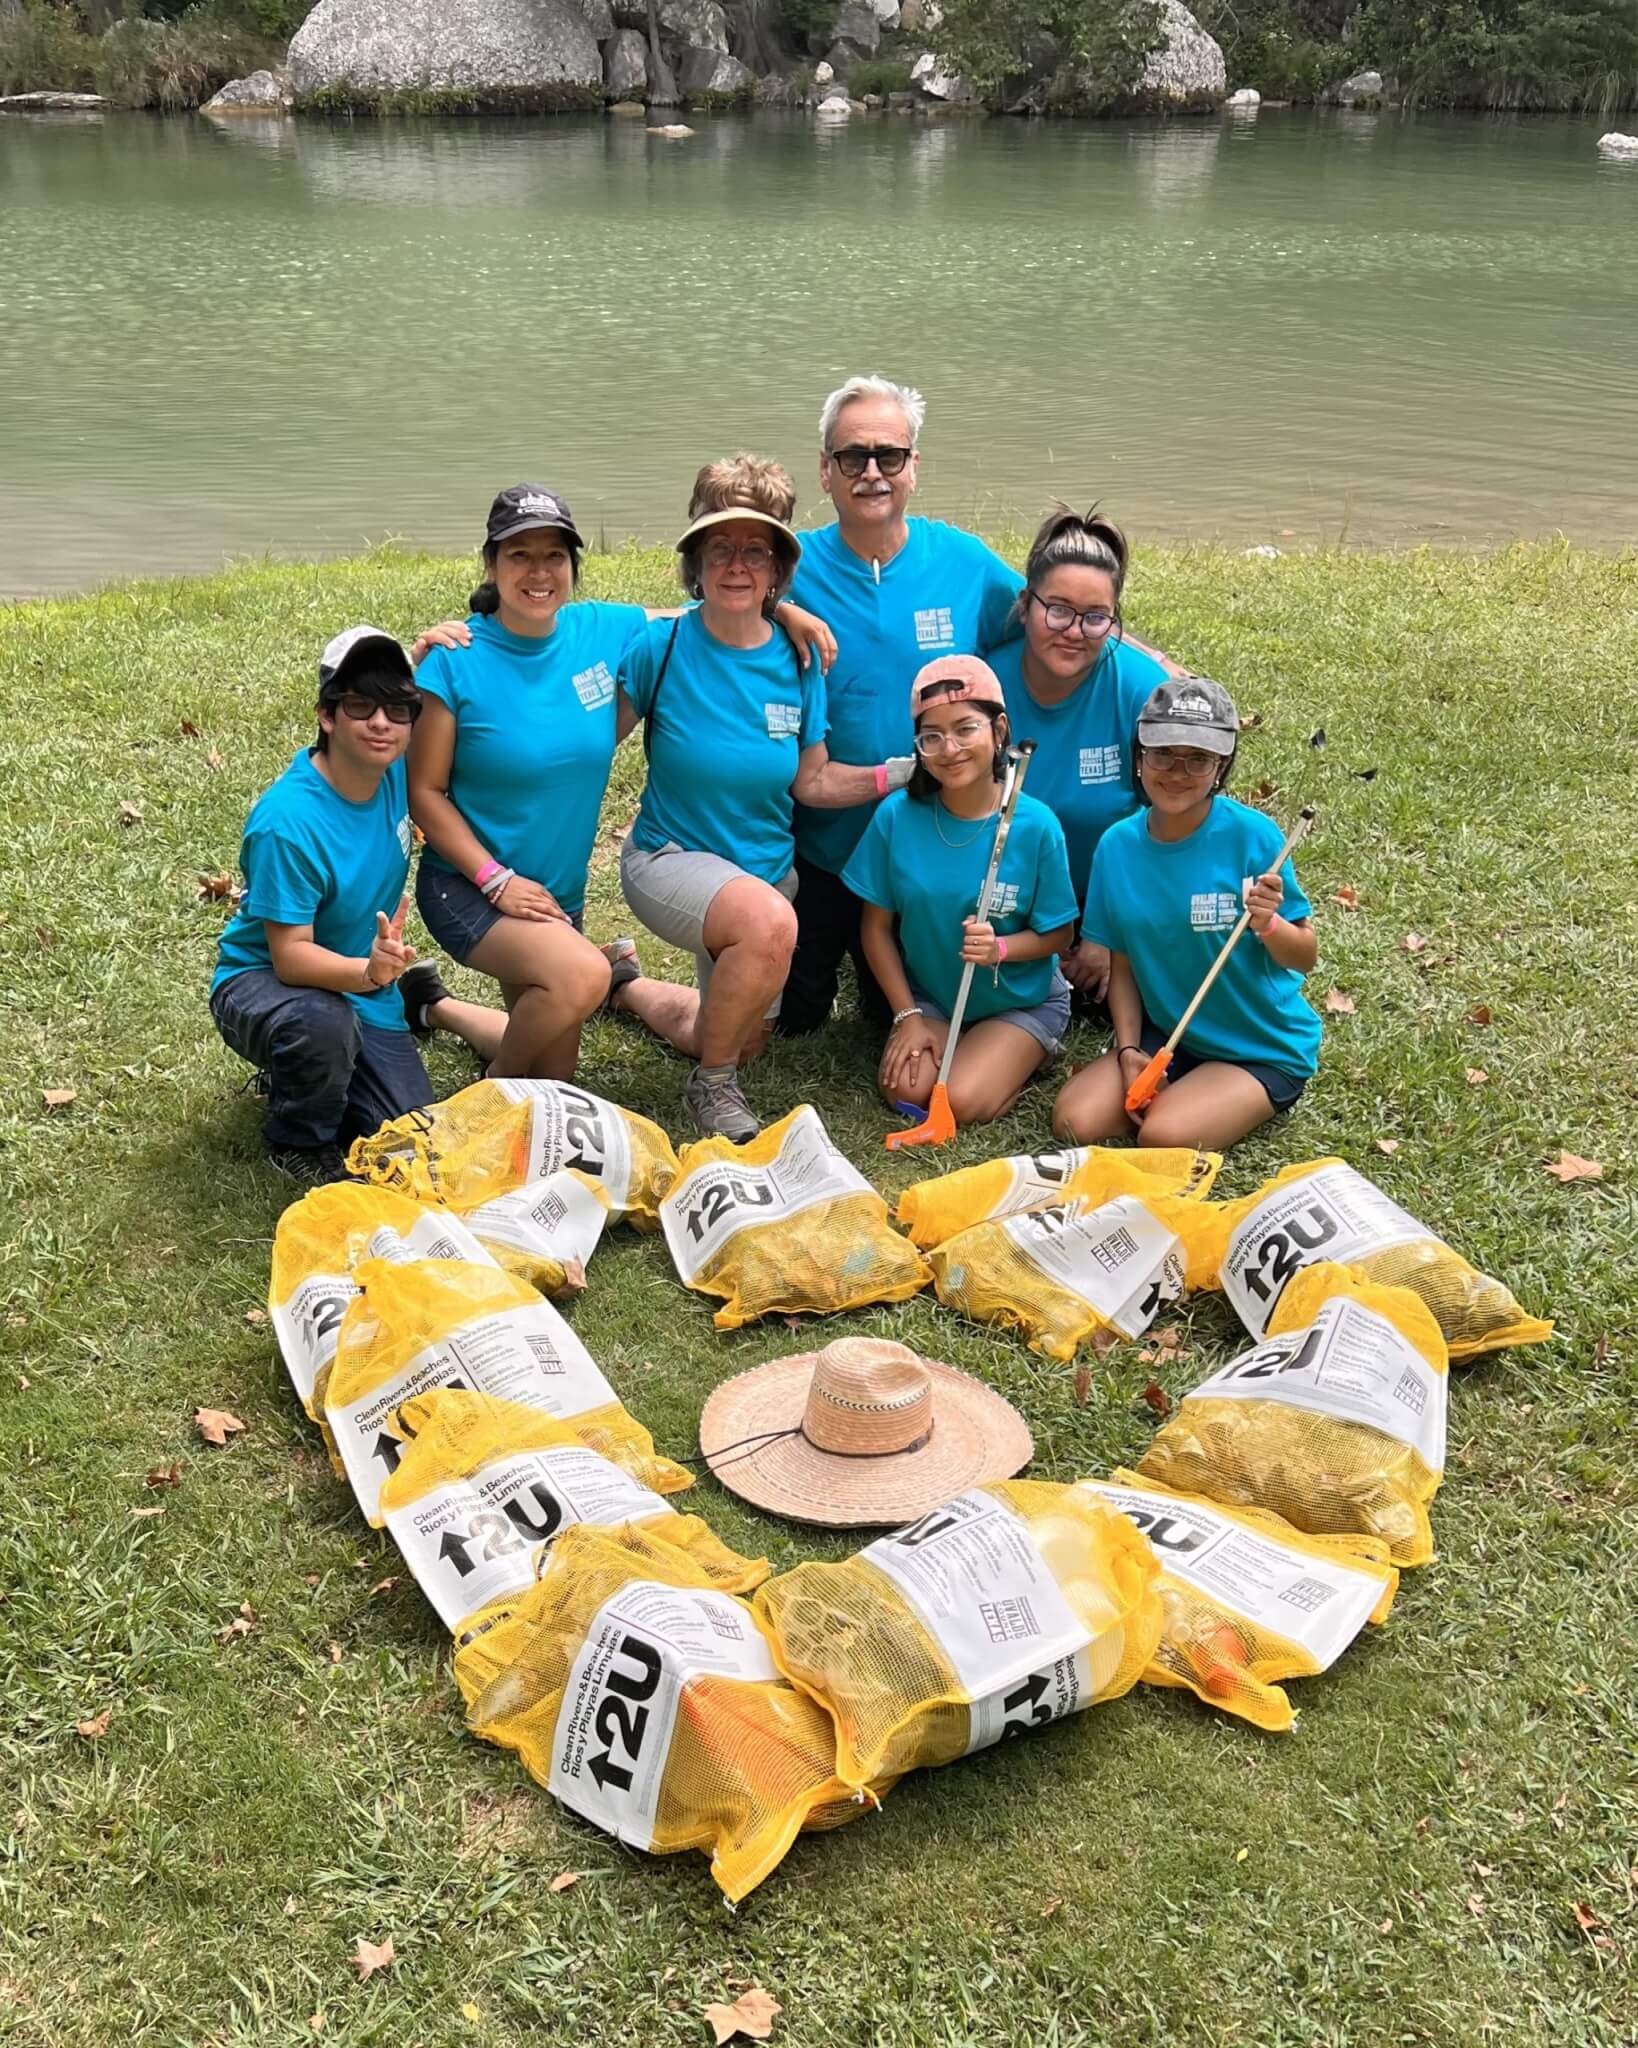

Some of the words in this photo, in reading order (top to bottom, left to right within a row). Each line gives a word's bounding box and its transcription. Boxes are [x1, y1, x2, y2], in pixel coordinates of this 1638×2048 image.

[556, 1088, 605, 1156] 2U
[540, 1150, 551, 1177] Clean
[698, 1181, 775, 1229] 2U
[1106, 1232, 1132, 1262] UVALDE
[1237, 1220, 1264, 1247] Rivers
[1246, 1219, 1277, 1250] Playas
[1257, 1205, 1339, 1284] 2U
[1091, 1244, 1119, 1273] TEXAS
[313, 1297, 349, 1340] 2
[353, 1402, 382, 1426] Clean
[378, 1384, 407, 1409] Rivers
[410, 1353, 450, 1385] Beaches
[415, 1364, 457, 1396] Limpias
[412, 1502, 448, 1527] Clean
[485, 1459, 534, 1492] Beaches
[494, 1469, 539, 1503] Limpias
[468, 1481, 563, 1562] 2U
[979, 1603, 1007, 1643] TEXAS
[1002, 1599, 1028, 1639] UVALDE
[581, 1624, 612, 1681] Beaches
[578, 1686, 600, 1734] Playas
[592, 1628, 622, 1685] Limpias
[595, 1635, 663, 1764] 2U
[568, 1692, 586, 1735] Rivers
[561, 1735, 576, 1774] Clean
